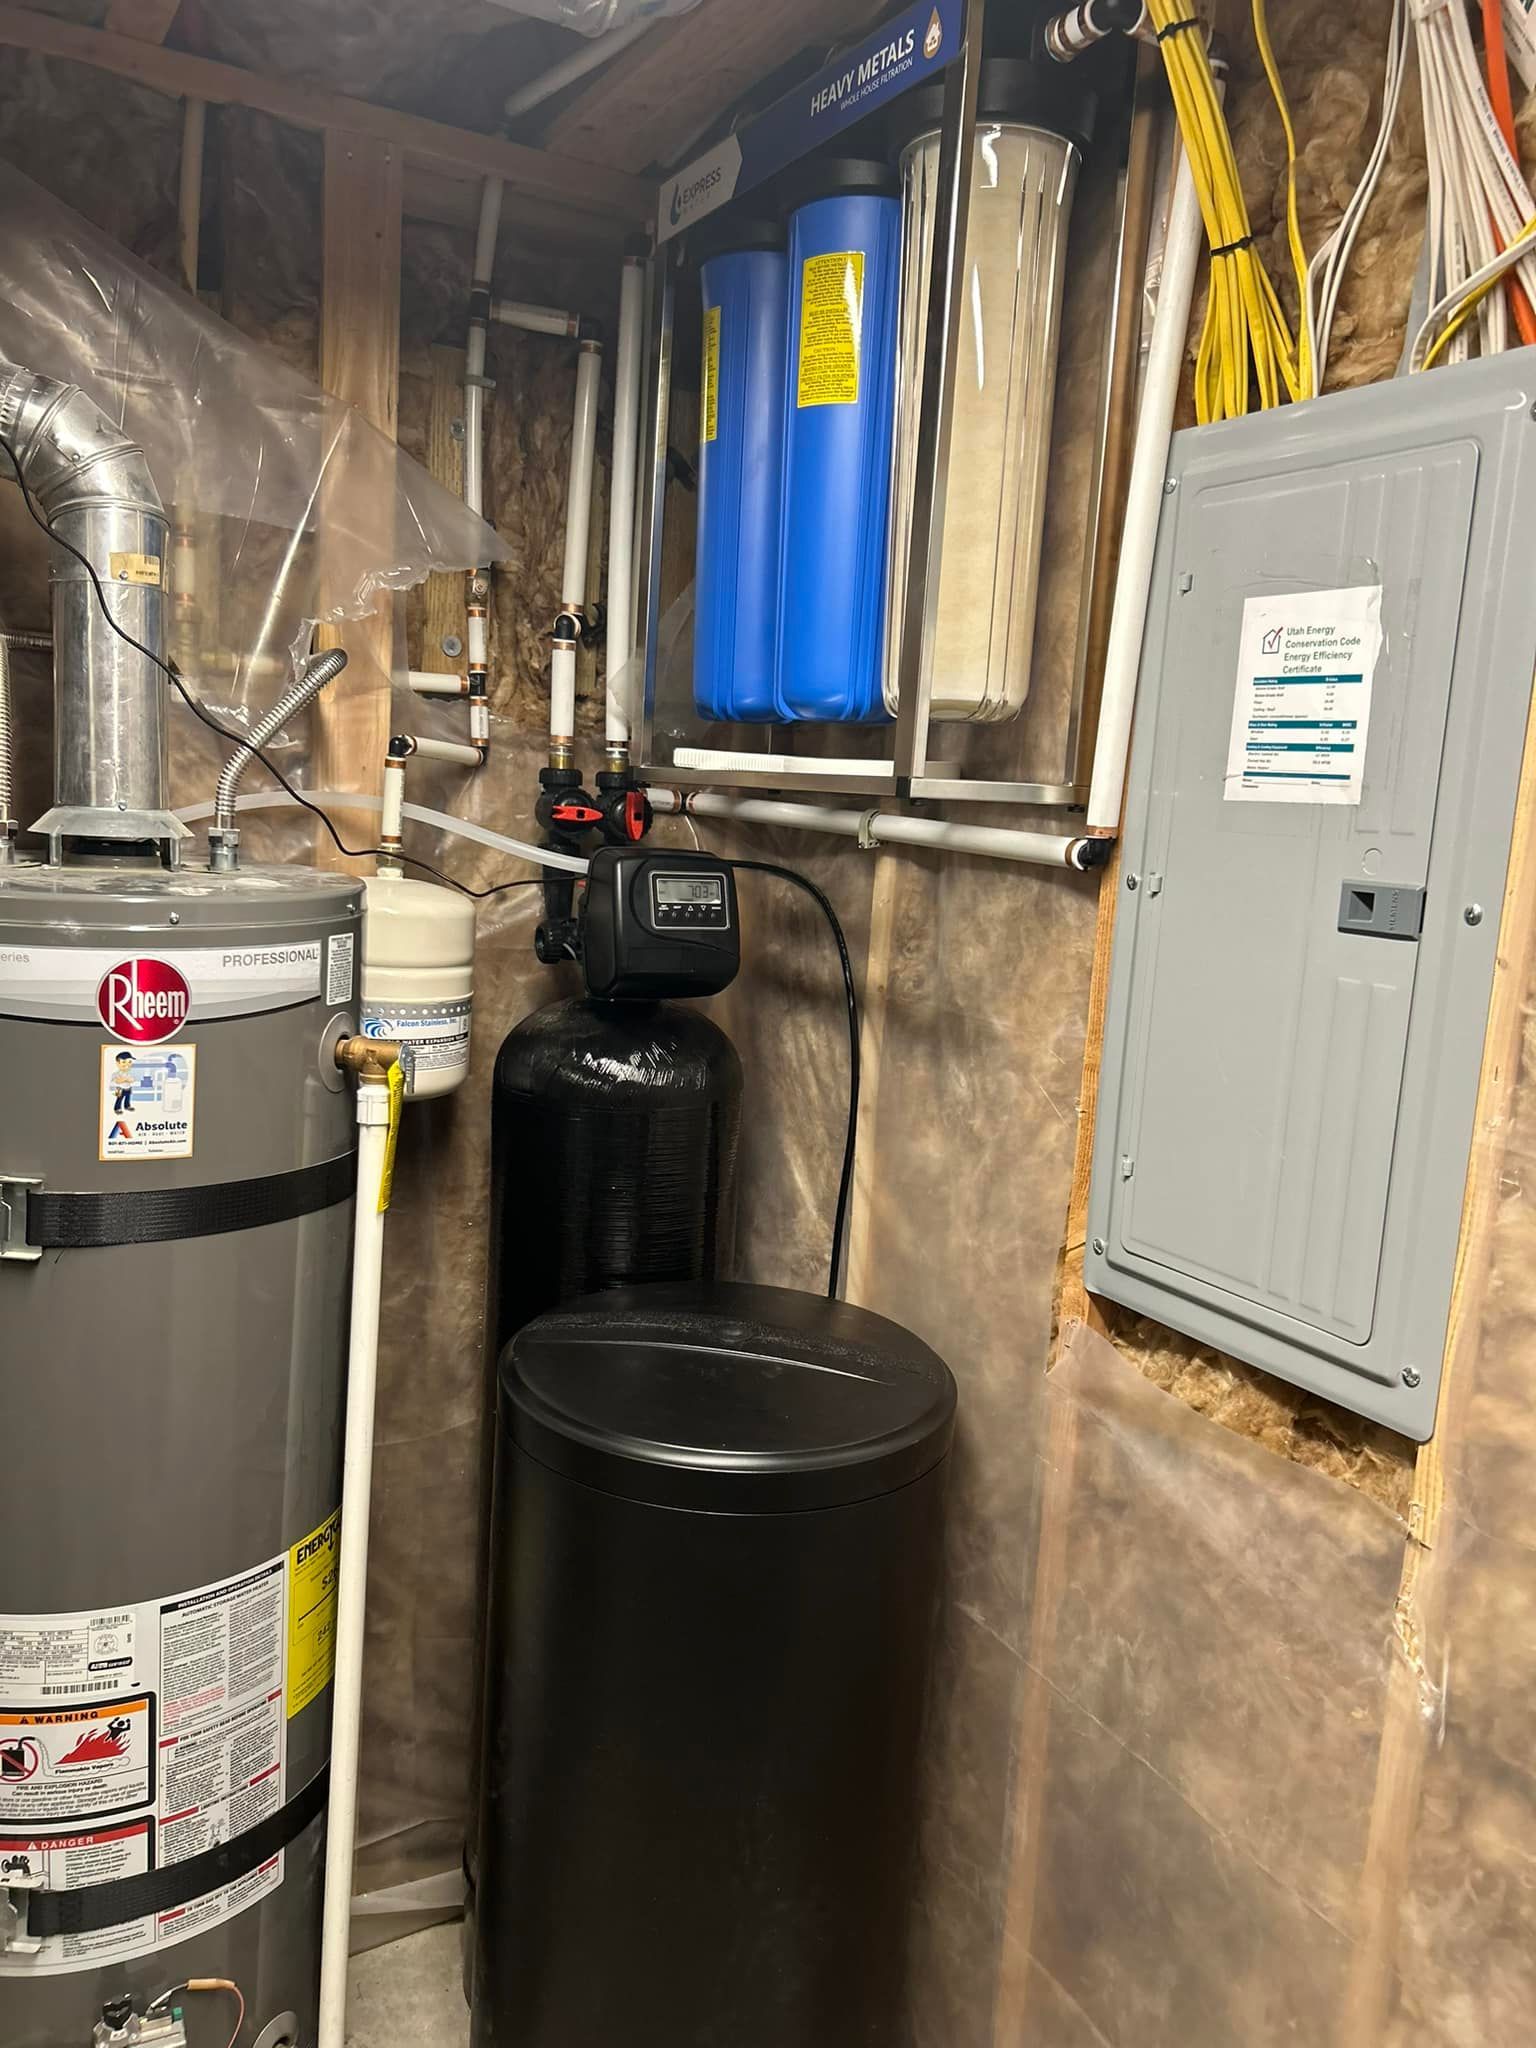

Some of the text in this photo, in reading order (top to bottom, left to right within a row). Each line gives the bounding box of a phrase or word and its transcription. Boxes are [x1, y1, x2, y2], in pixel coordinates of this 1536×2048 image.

[810, 28, 915, 117] HEAVY METALS
[840, 57, 913, 111] WHOLE HOUSE FILTRATION
[682, 167, 721, 205] EXPRESS
[1286, 625, 1336, 636] Utah Energy
[1285, 636, 1361, 648] Conservation Code
[1283, 650, 1353, 662] Energy Efficiency
[1282, 664, 1322, 674] Certificate
[0, 951, 30, 963] eries
[223, 948, 318, 968] PROFESSIONAL
[108, 959, 186, 1031] Rheem
[136, 1121, 188, 1131] Absolute
[216, 1588, 227, 1596] AND
[34, 1711, 99, 1724] WARNING
[55, 1763, 114, 1774] Flammable Vapors
[44, 1782, 77, 1790] EXPLOSION
[41, 1837, 94, 1849] DANGER
